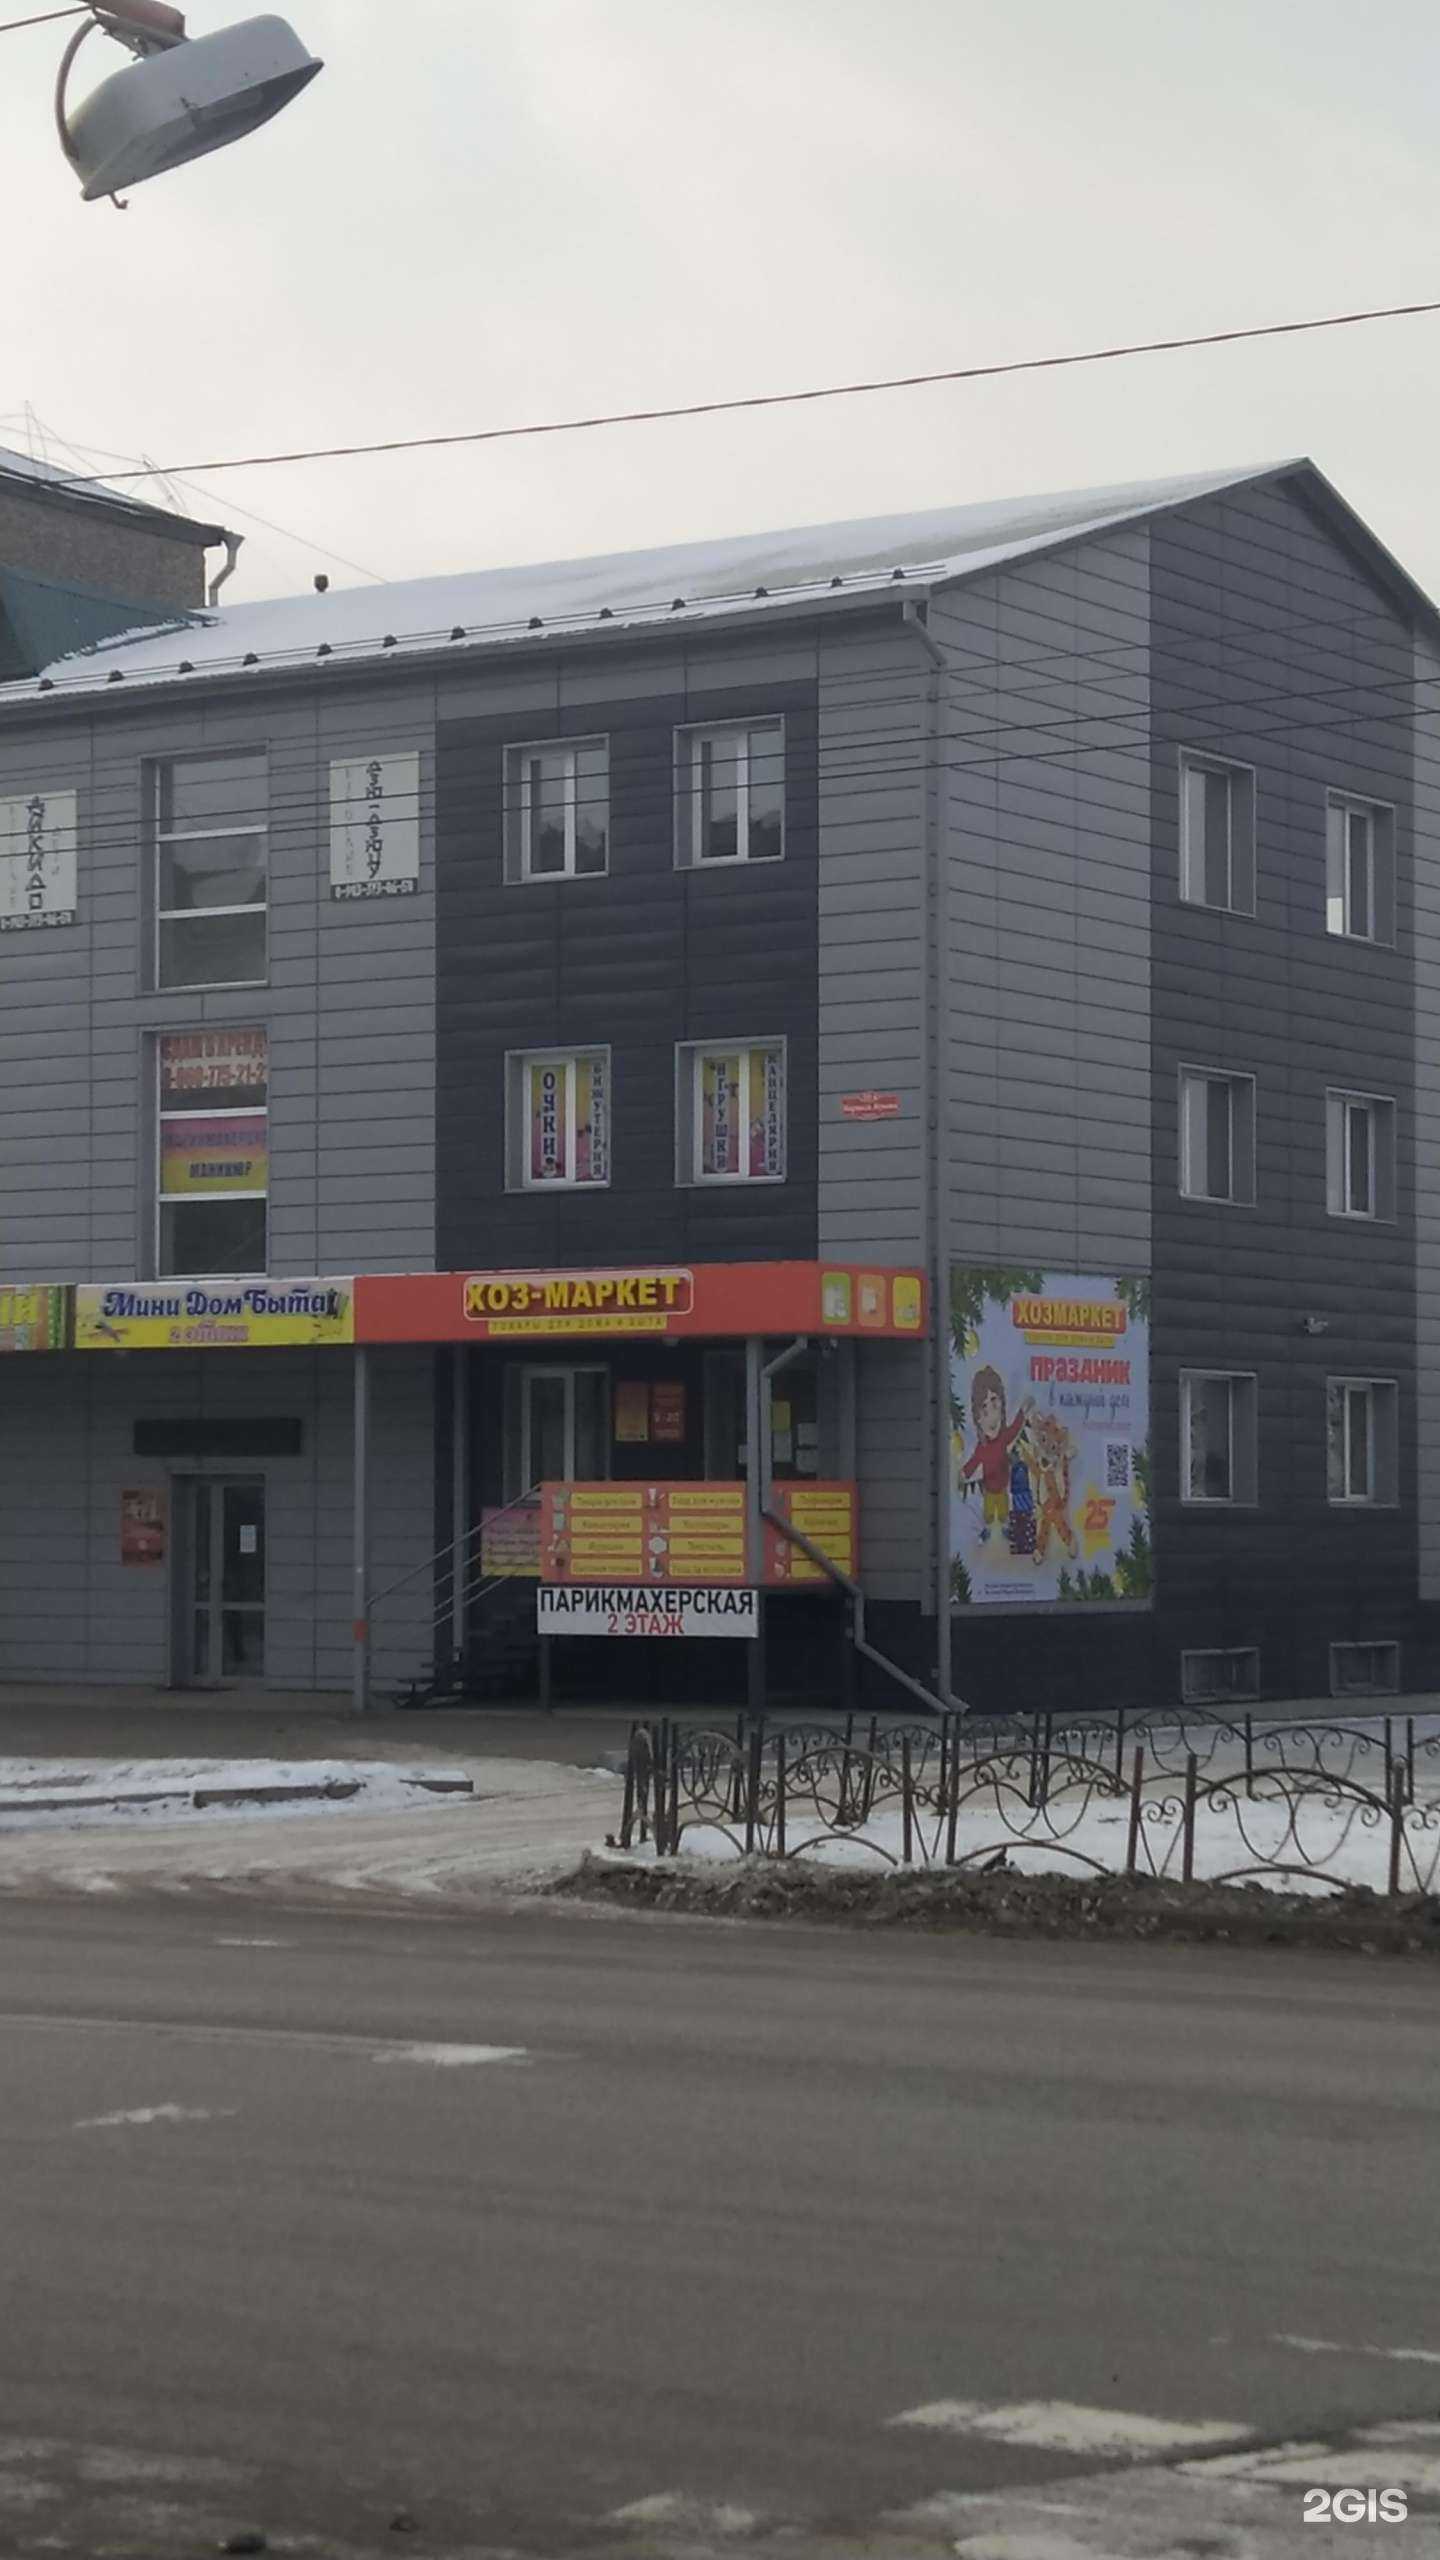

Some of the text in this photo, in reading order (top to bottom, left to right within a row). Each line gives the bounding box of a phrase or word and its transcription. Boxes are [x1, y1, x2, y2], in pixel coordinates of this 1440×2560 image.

[543, 1072, 556, 1156] ОЧКИ
[716, 1062, 728, 1170] ИГРУШКИ
[103, 1288, 325, 1316] Мини Дом Быта
[467, 1275, 680, 1311] ХОЗ-МАРКЕТ
[1017, 1301, 1122, 1329] ХОЗМАРКЕТ
[540, 1589, 753, 1615] ПАРИКМАХЕРСКАЯ
[607, 1613, 685, 1634] 2 ЭТАЖ
